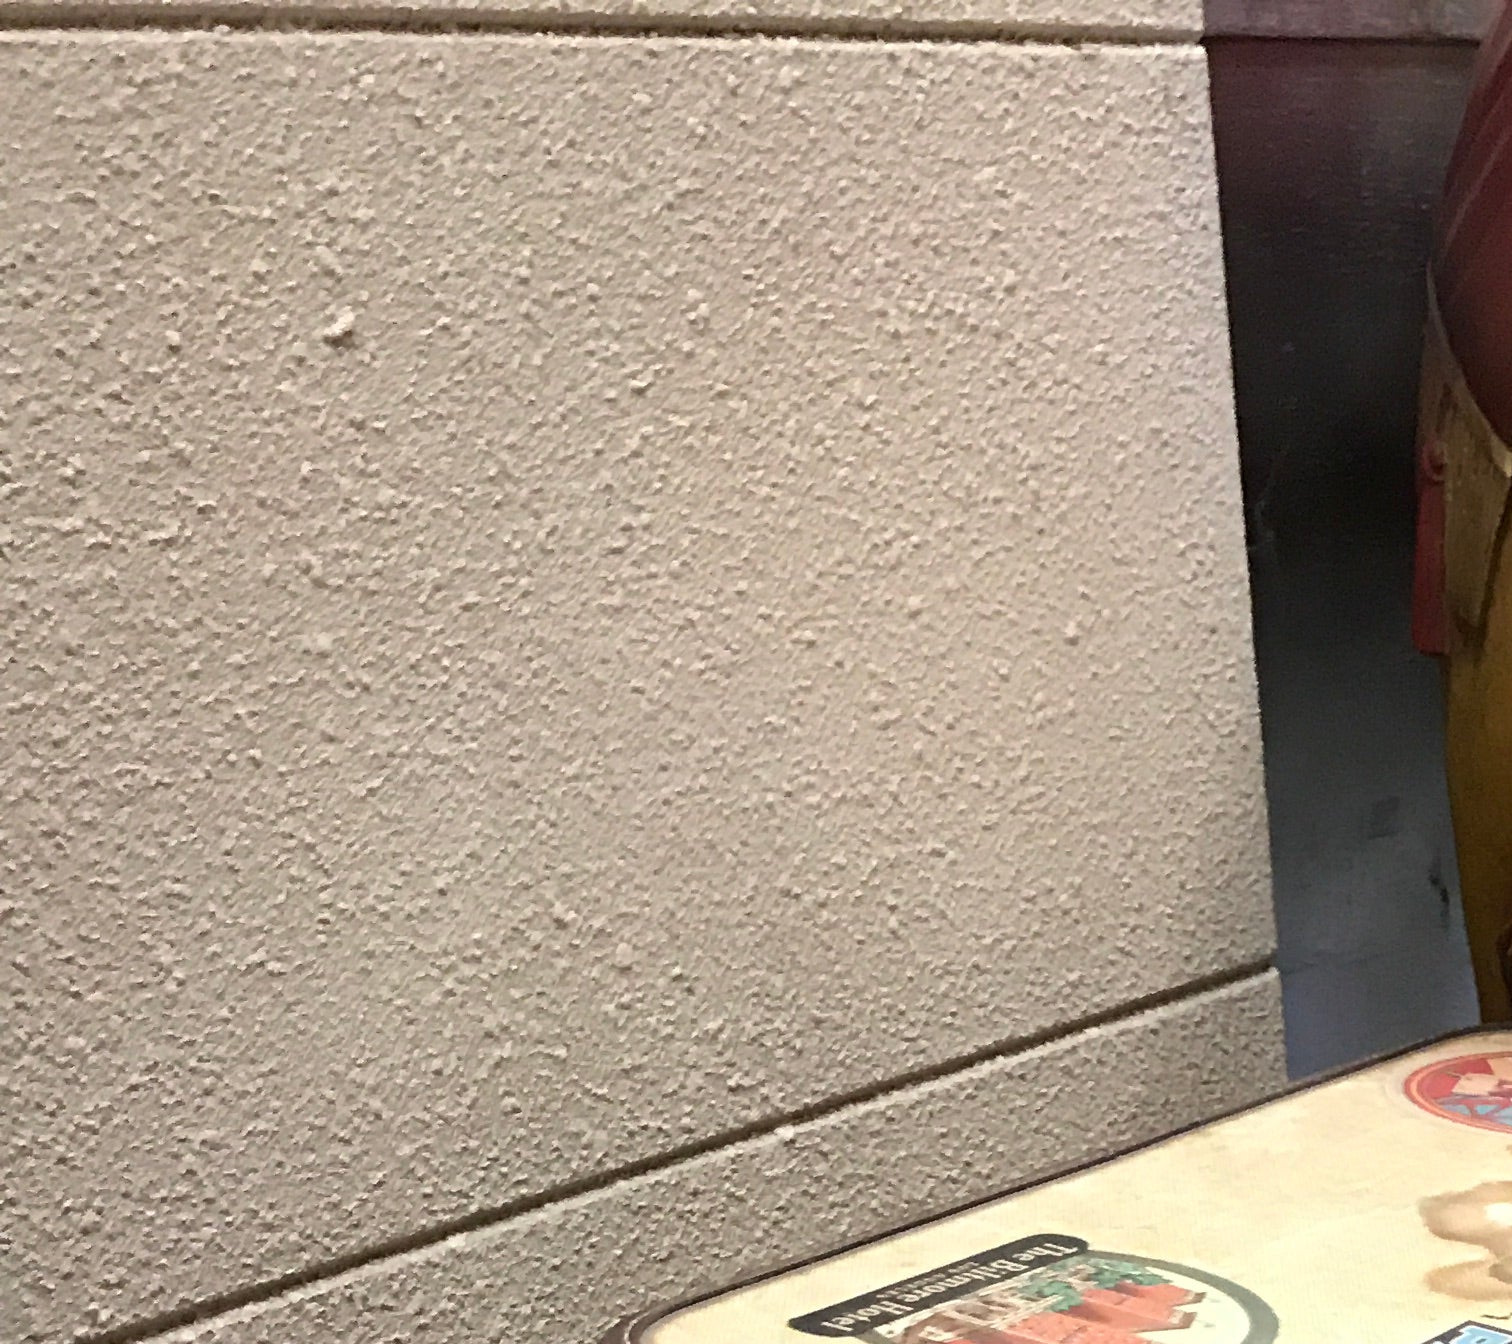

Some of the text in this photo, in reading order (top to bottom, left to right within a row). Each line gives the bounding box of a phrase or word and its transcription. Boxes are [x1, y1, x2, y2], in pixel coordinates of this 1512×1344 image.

[820, 1242, 1079, 1333] The Biltmore Hotel
